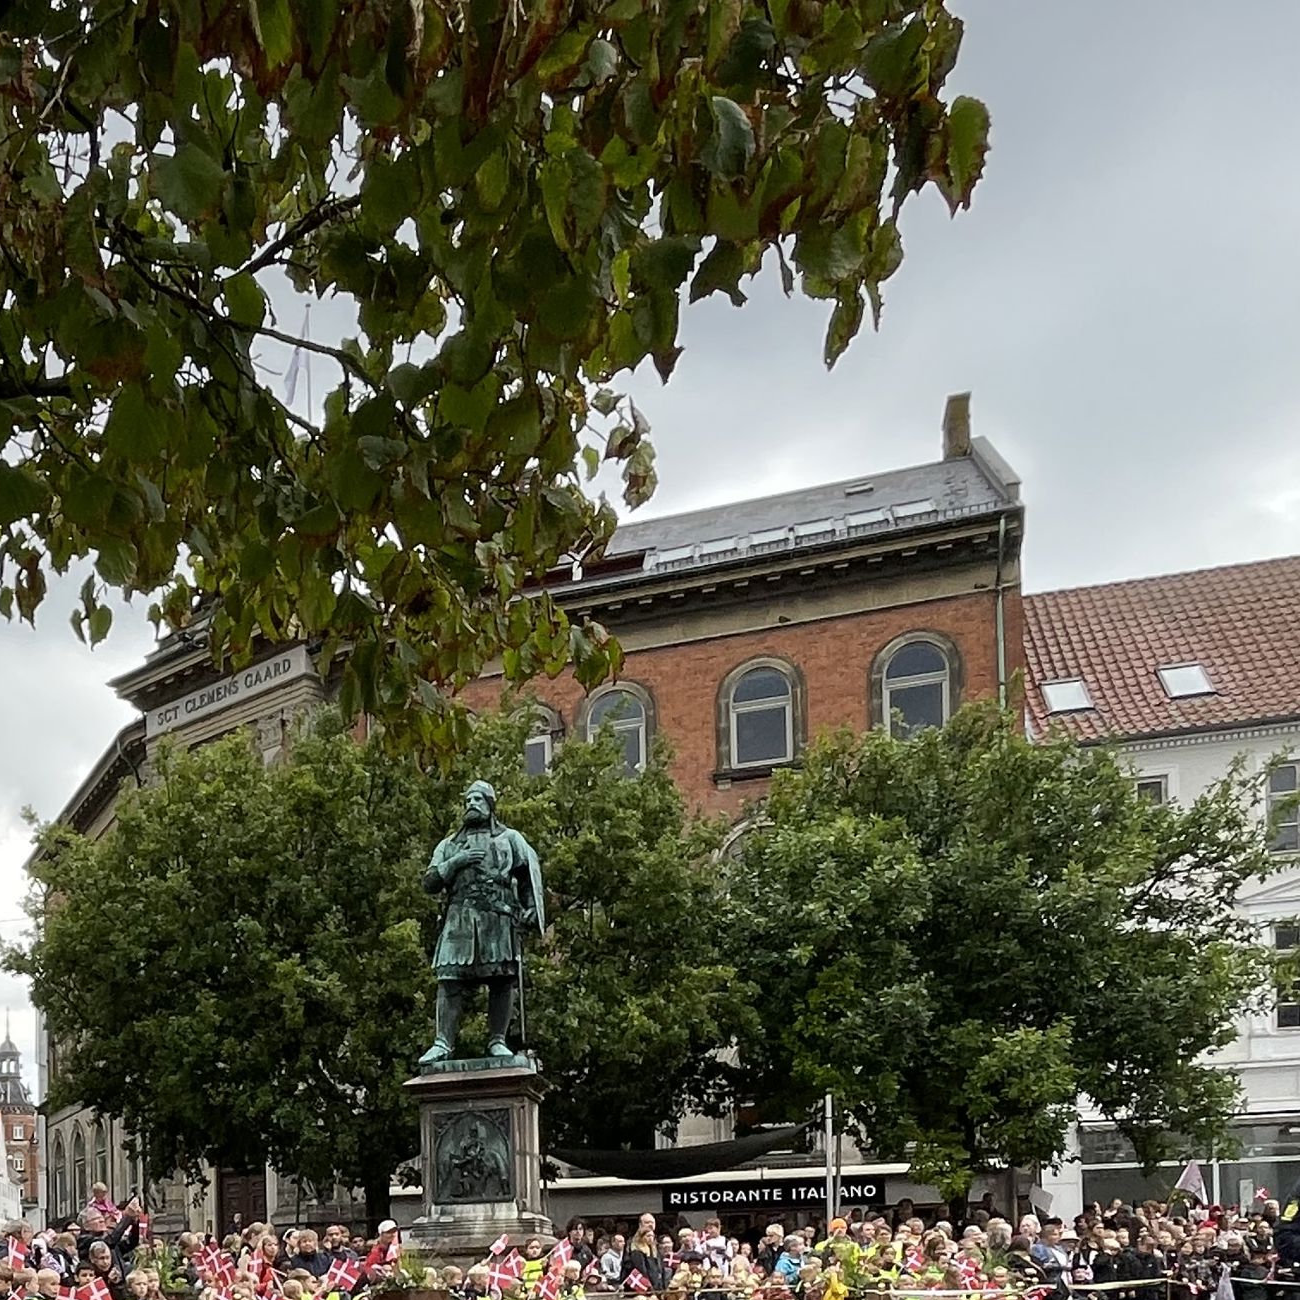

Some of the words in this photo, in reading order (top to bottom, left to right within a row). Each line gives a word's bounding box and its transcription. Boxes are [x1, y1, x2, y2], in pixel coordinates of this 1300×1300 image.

[157, 705, 180, 726] SCT
[185, 680, 239, 713] CLEMENS
[244, 658, 292, 689] GAARD
[670, 1188, 782, 1205] RISTORANTE
[792, 1185, 876, 1201] ITALANO
